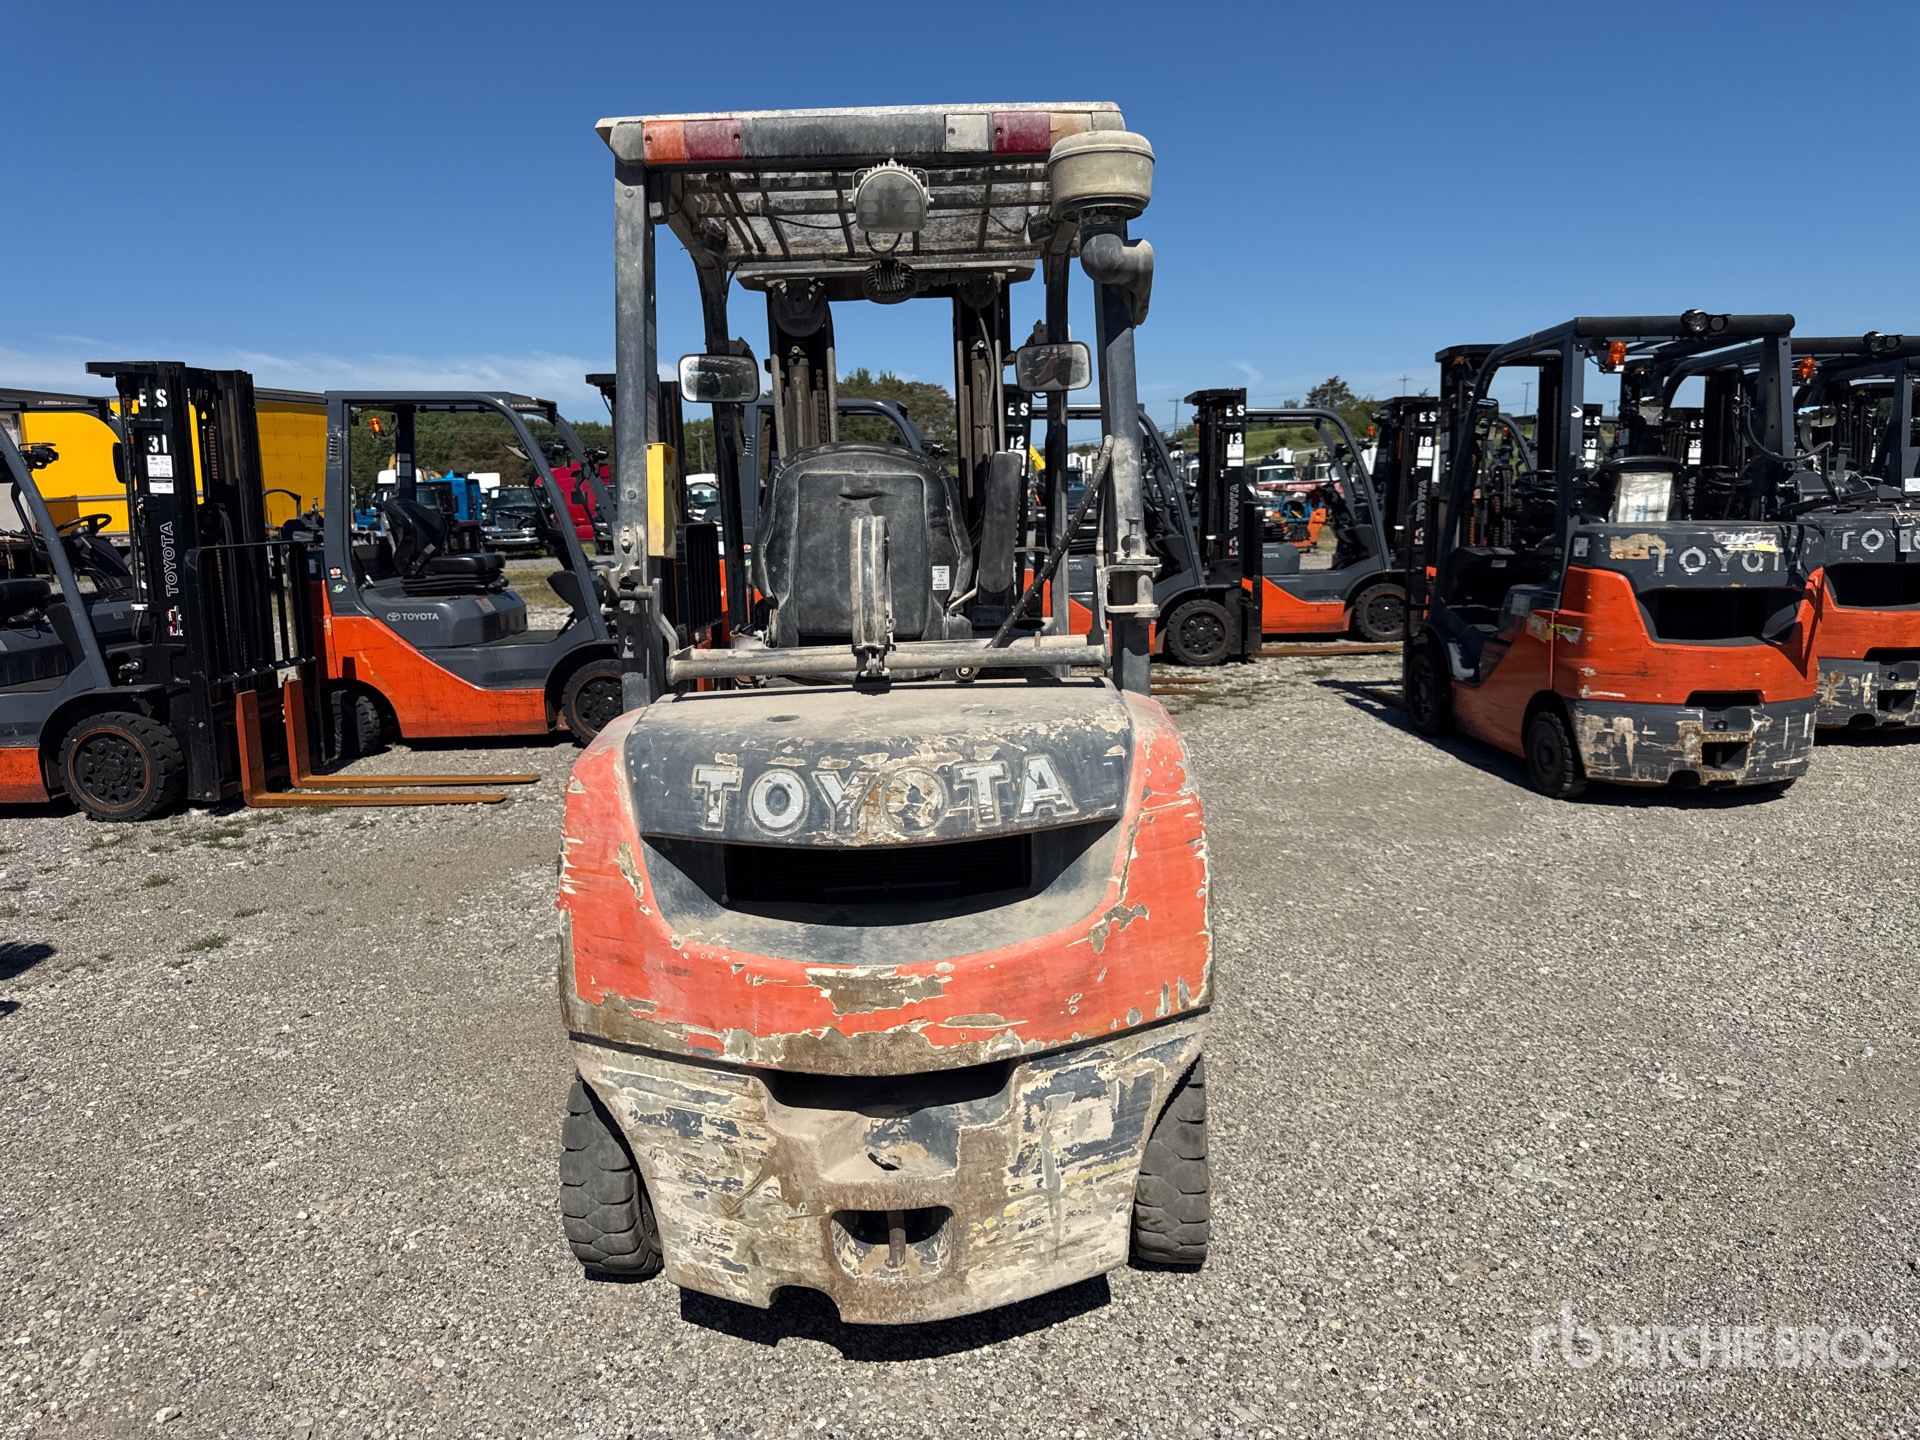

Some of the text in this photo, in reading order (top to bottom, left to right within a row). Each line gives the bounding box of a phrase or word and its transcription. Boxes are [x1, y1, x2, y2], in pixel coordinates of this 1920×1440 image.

[148, 434, 168, 453] 31
[1009, 435, 1025, 449] 12
[1229, 432, 1243, 444] 13
[1419, 436, 1432, 446] 18
[1583, 438, 1597, 448] 33
[160, 521, 179, 597] TOYOTA
[402, 612, 440, 621] TOYOTA
[691, 753, 1080, 836] TOYOTA
